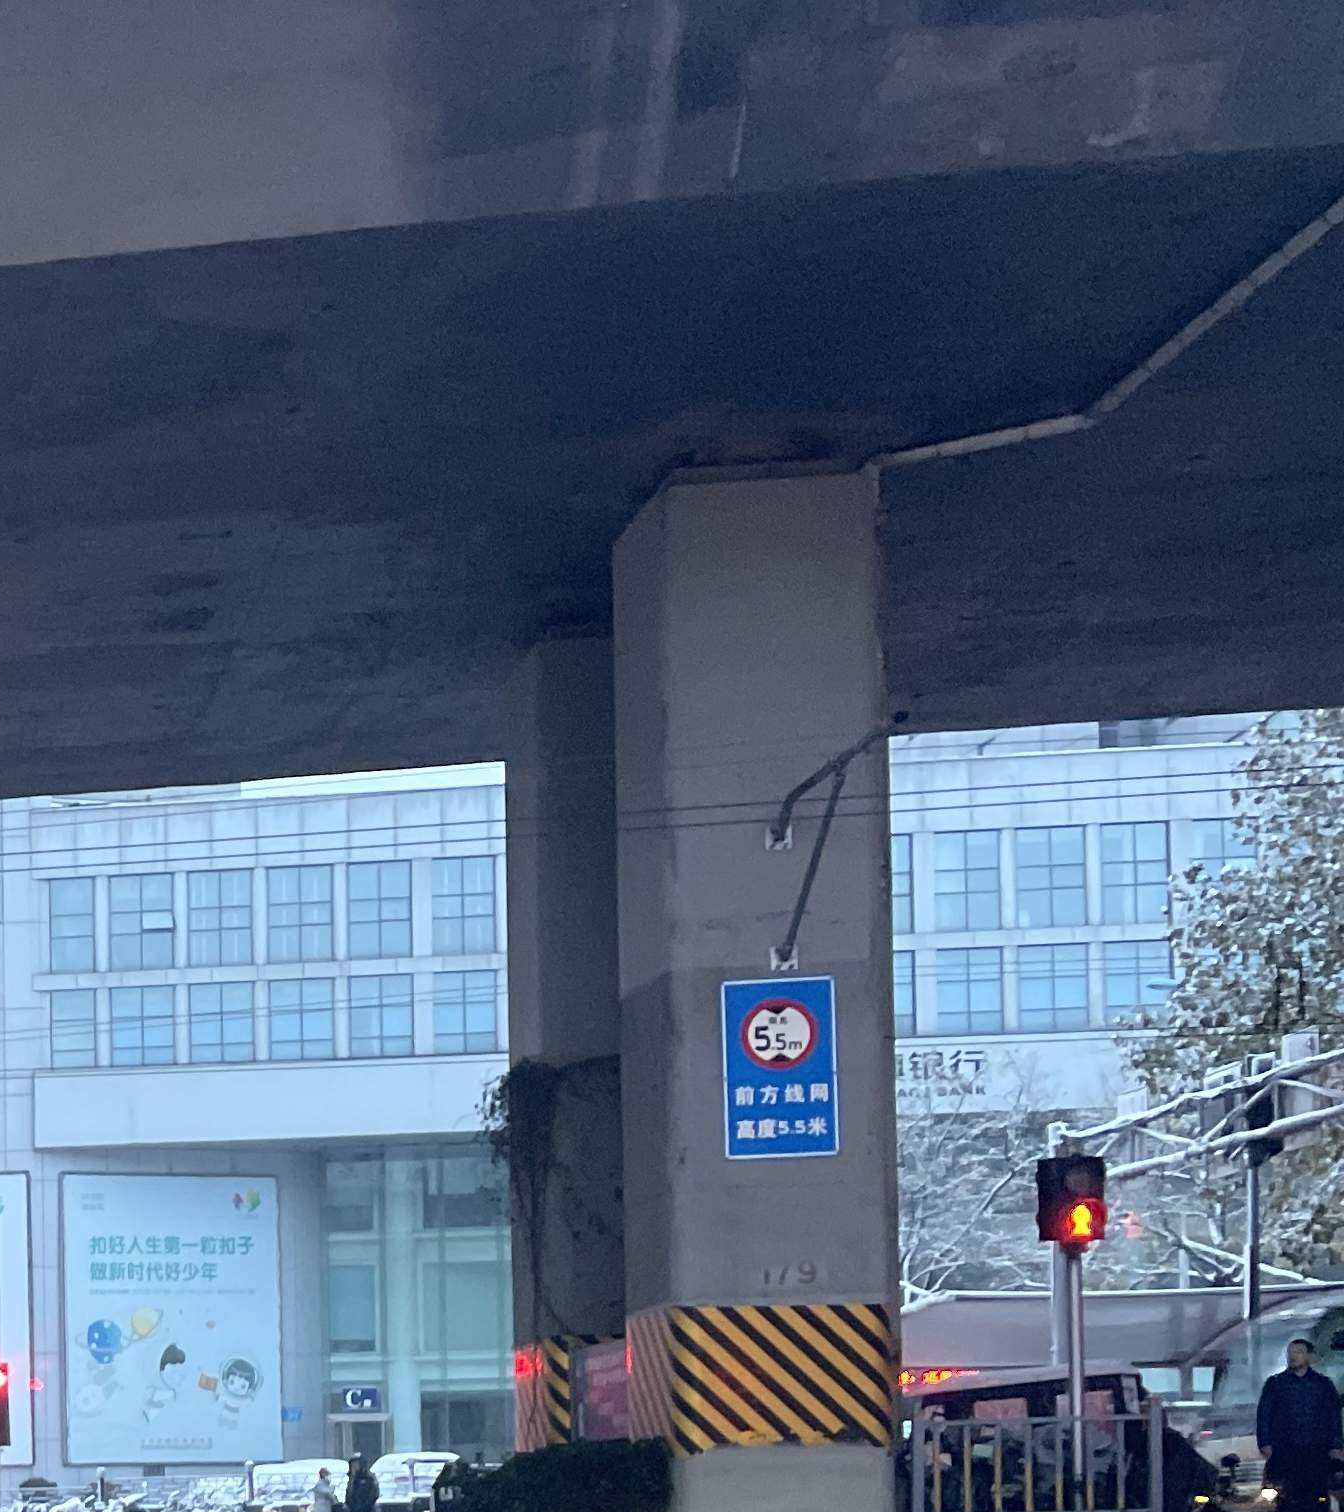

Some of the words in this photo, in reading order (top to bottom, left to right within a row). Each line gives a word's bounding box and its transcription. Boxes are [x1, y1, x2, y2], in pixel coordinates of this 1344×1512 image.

[735, 1083, 829, 1106] 前方线网
[736, 1116, 828, 1139] 高度5.5米
[88, 1235, 255, 1256] 扣好人生第一粒扣子
[89, 1262, 219, 1282] 做新时代好少年
